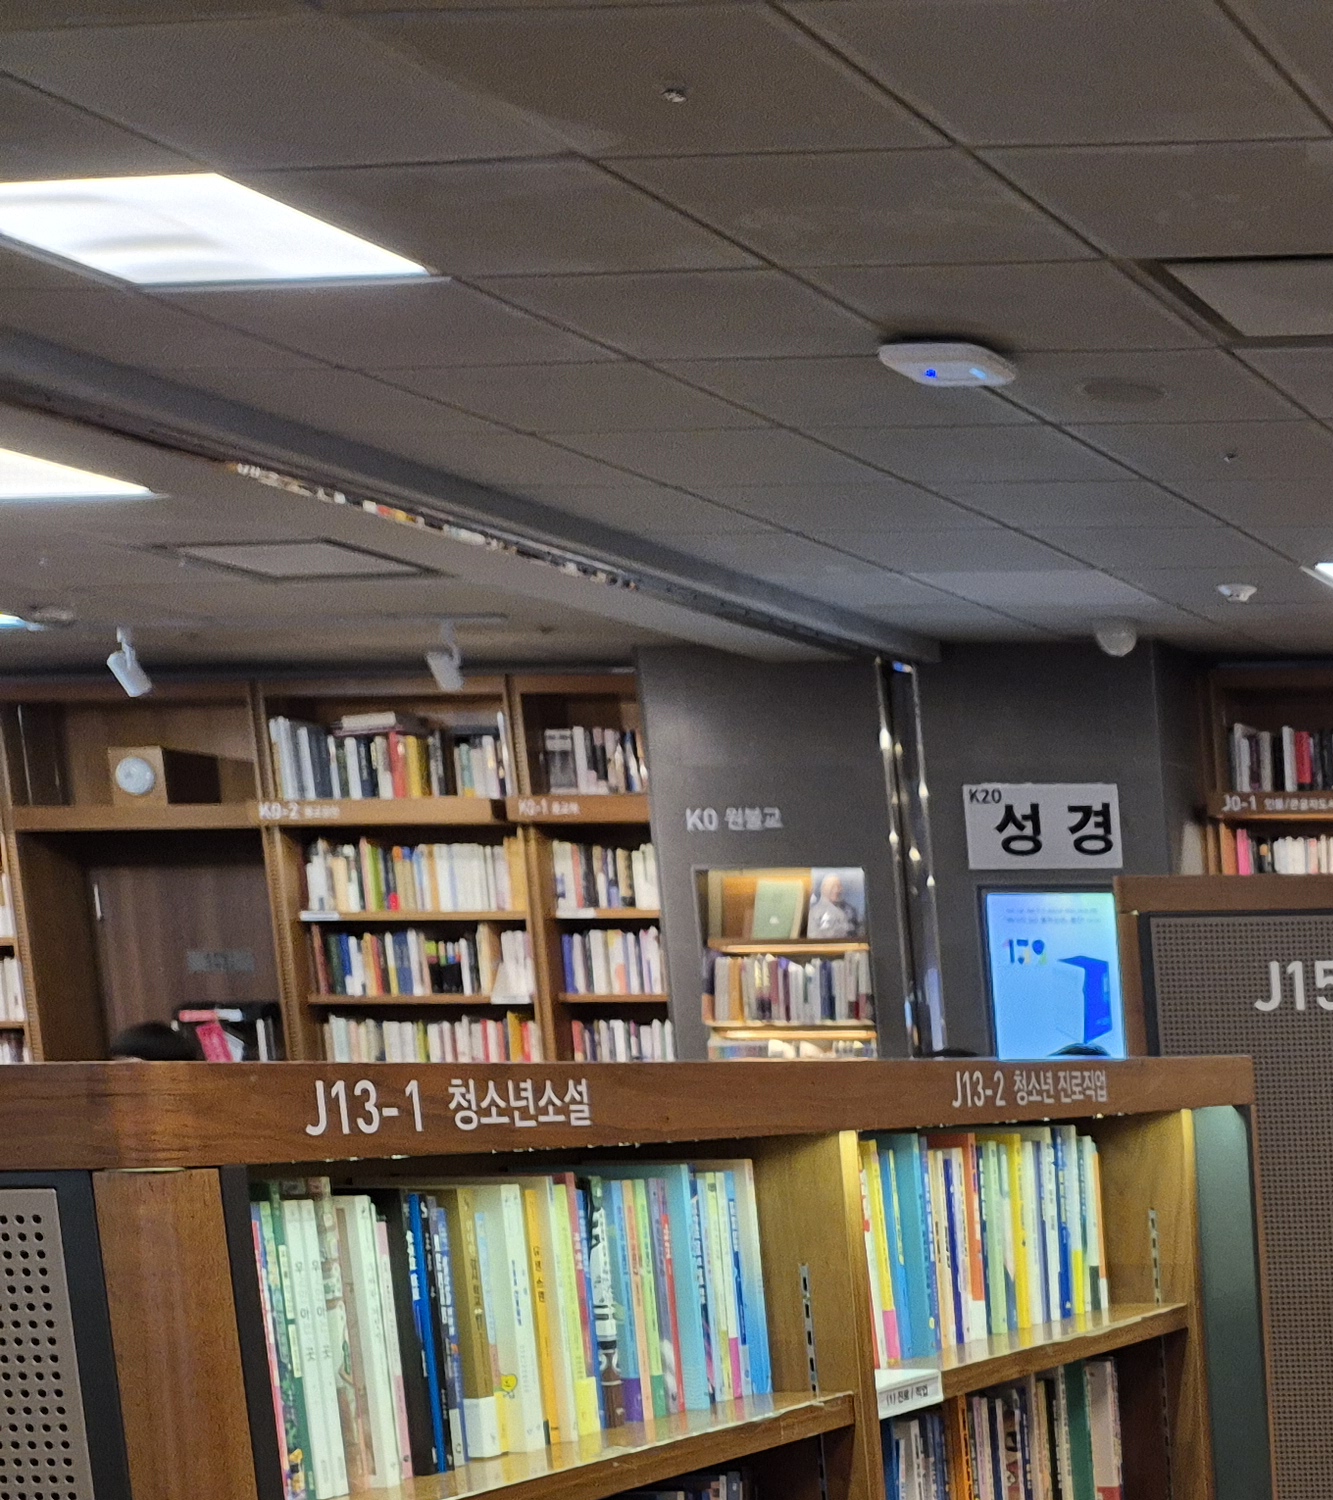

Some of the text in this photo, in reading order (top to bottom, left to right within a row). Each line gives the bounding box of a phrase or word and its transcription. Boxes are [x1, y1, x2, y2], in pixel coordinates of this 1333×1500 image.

[968, 788, 1002, 804] K20
[724, 806, 784, 831] 원불교
[952, 1069, 1108, 1108] J13-2 청소년 진로직업
[306, 1077, 592, 1136] J13-1 청소년소설
